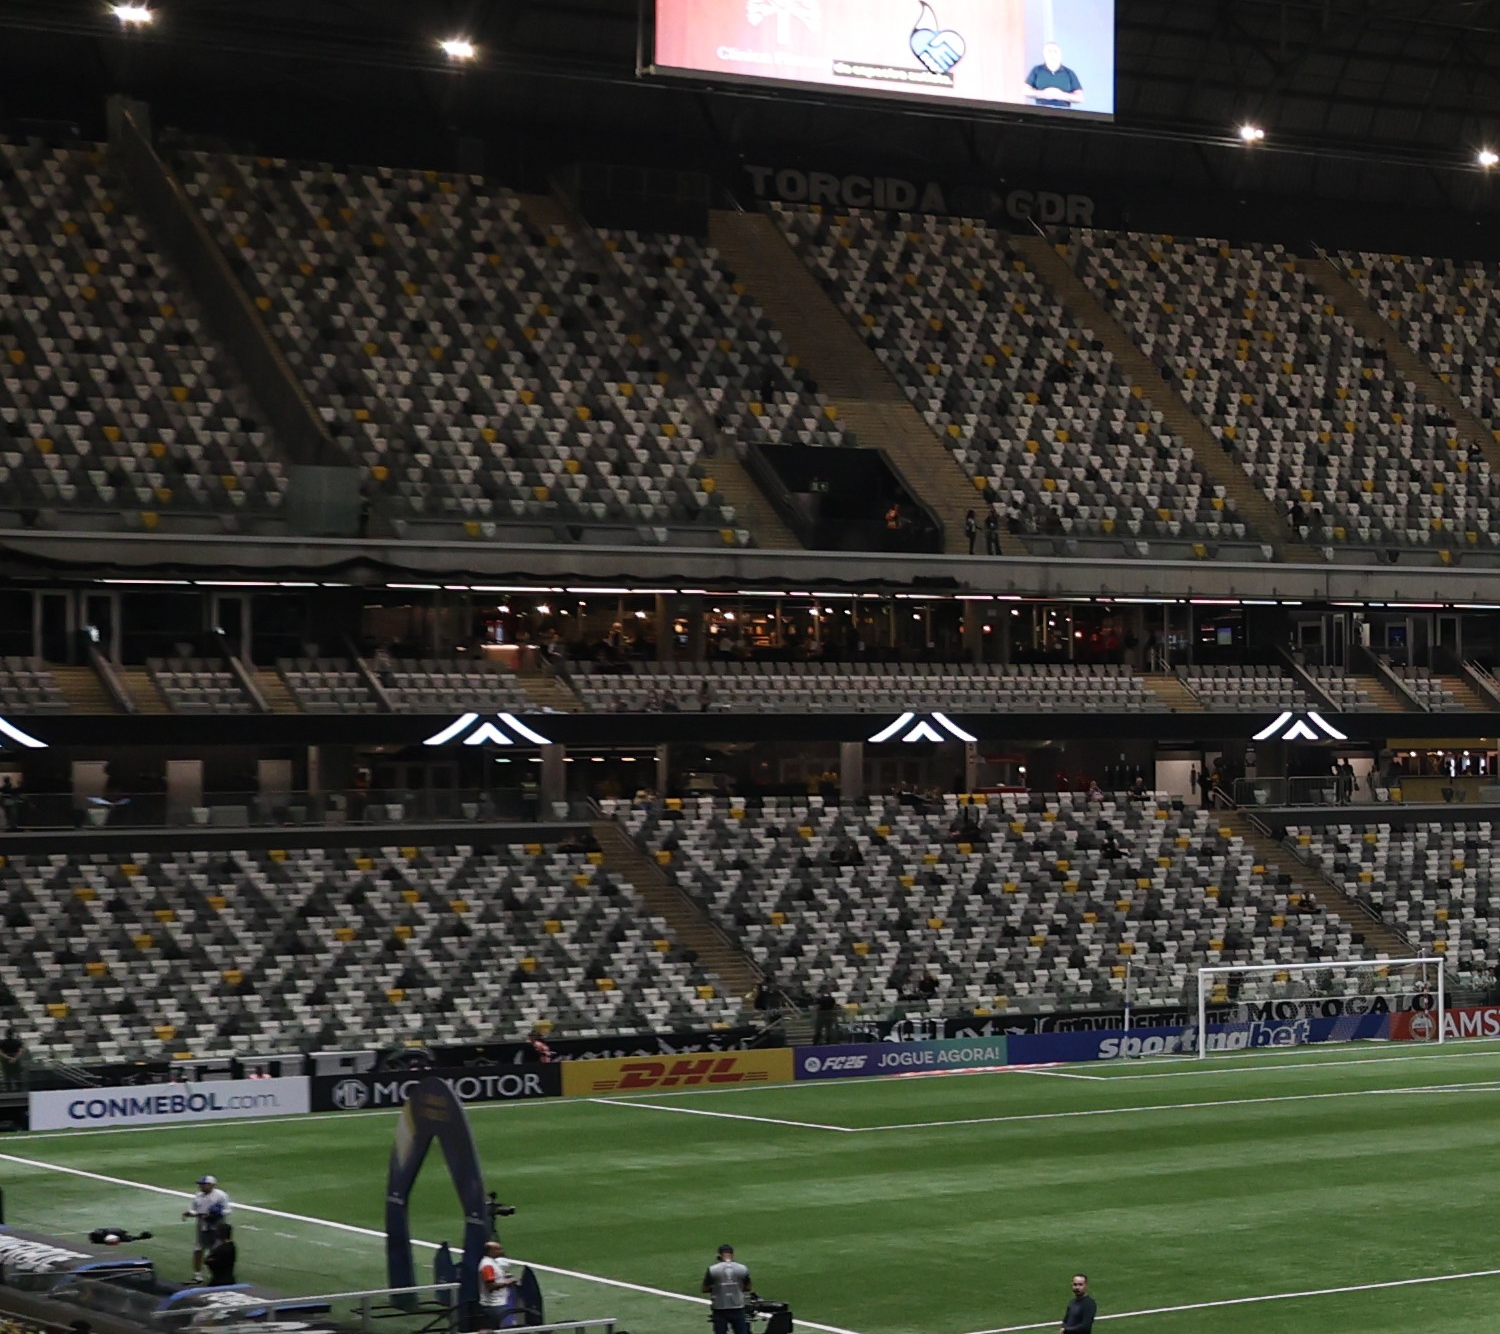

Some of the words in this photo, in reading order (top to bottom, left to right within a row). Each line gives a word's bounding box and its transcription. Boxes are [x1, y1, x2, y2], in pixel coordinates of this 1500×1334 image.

[743, 164, 948, 214] TORCIDA
[1005, 189, 1096, 226] GDR
[1247, 993, 1434, 1023] MOTOGALO
[878, 1050, 934, 1068] JOGUE
[937, 1046, 1000, 1064] AGORA!
[617, 1058, 745, 1091] DHL
[68, 1090, 280, 1120] CONMEBOL.com
